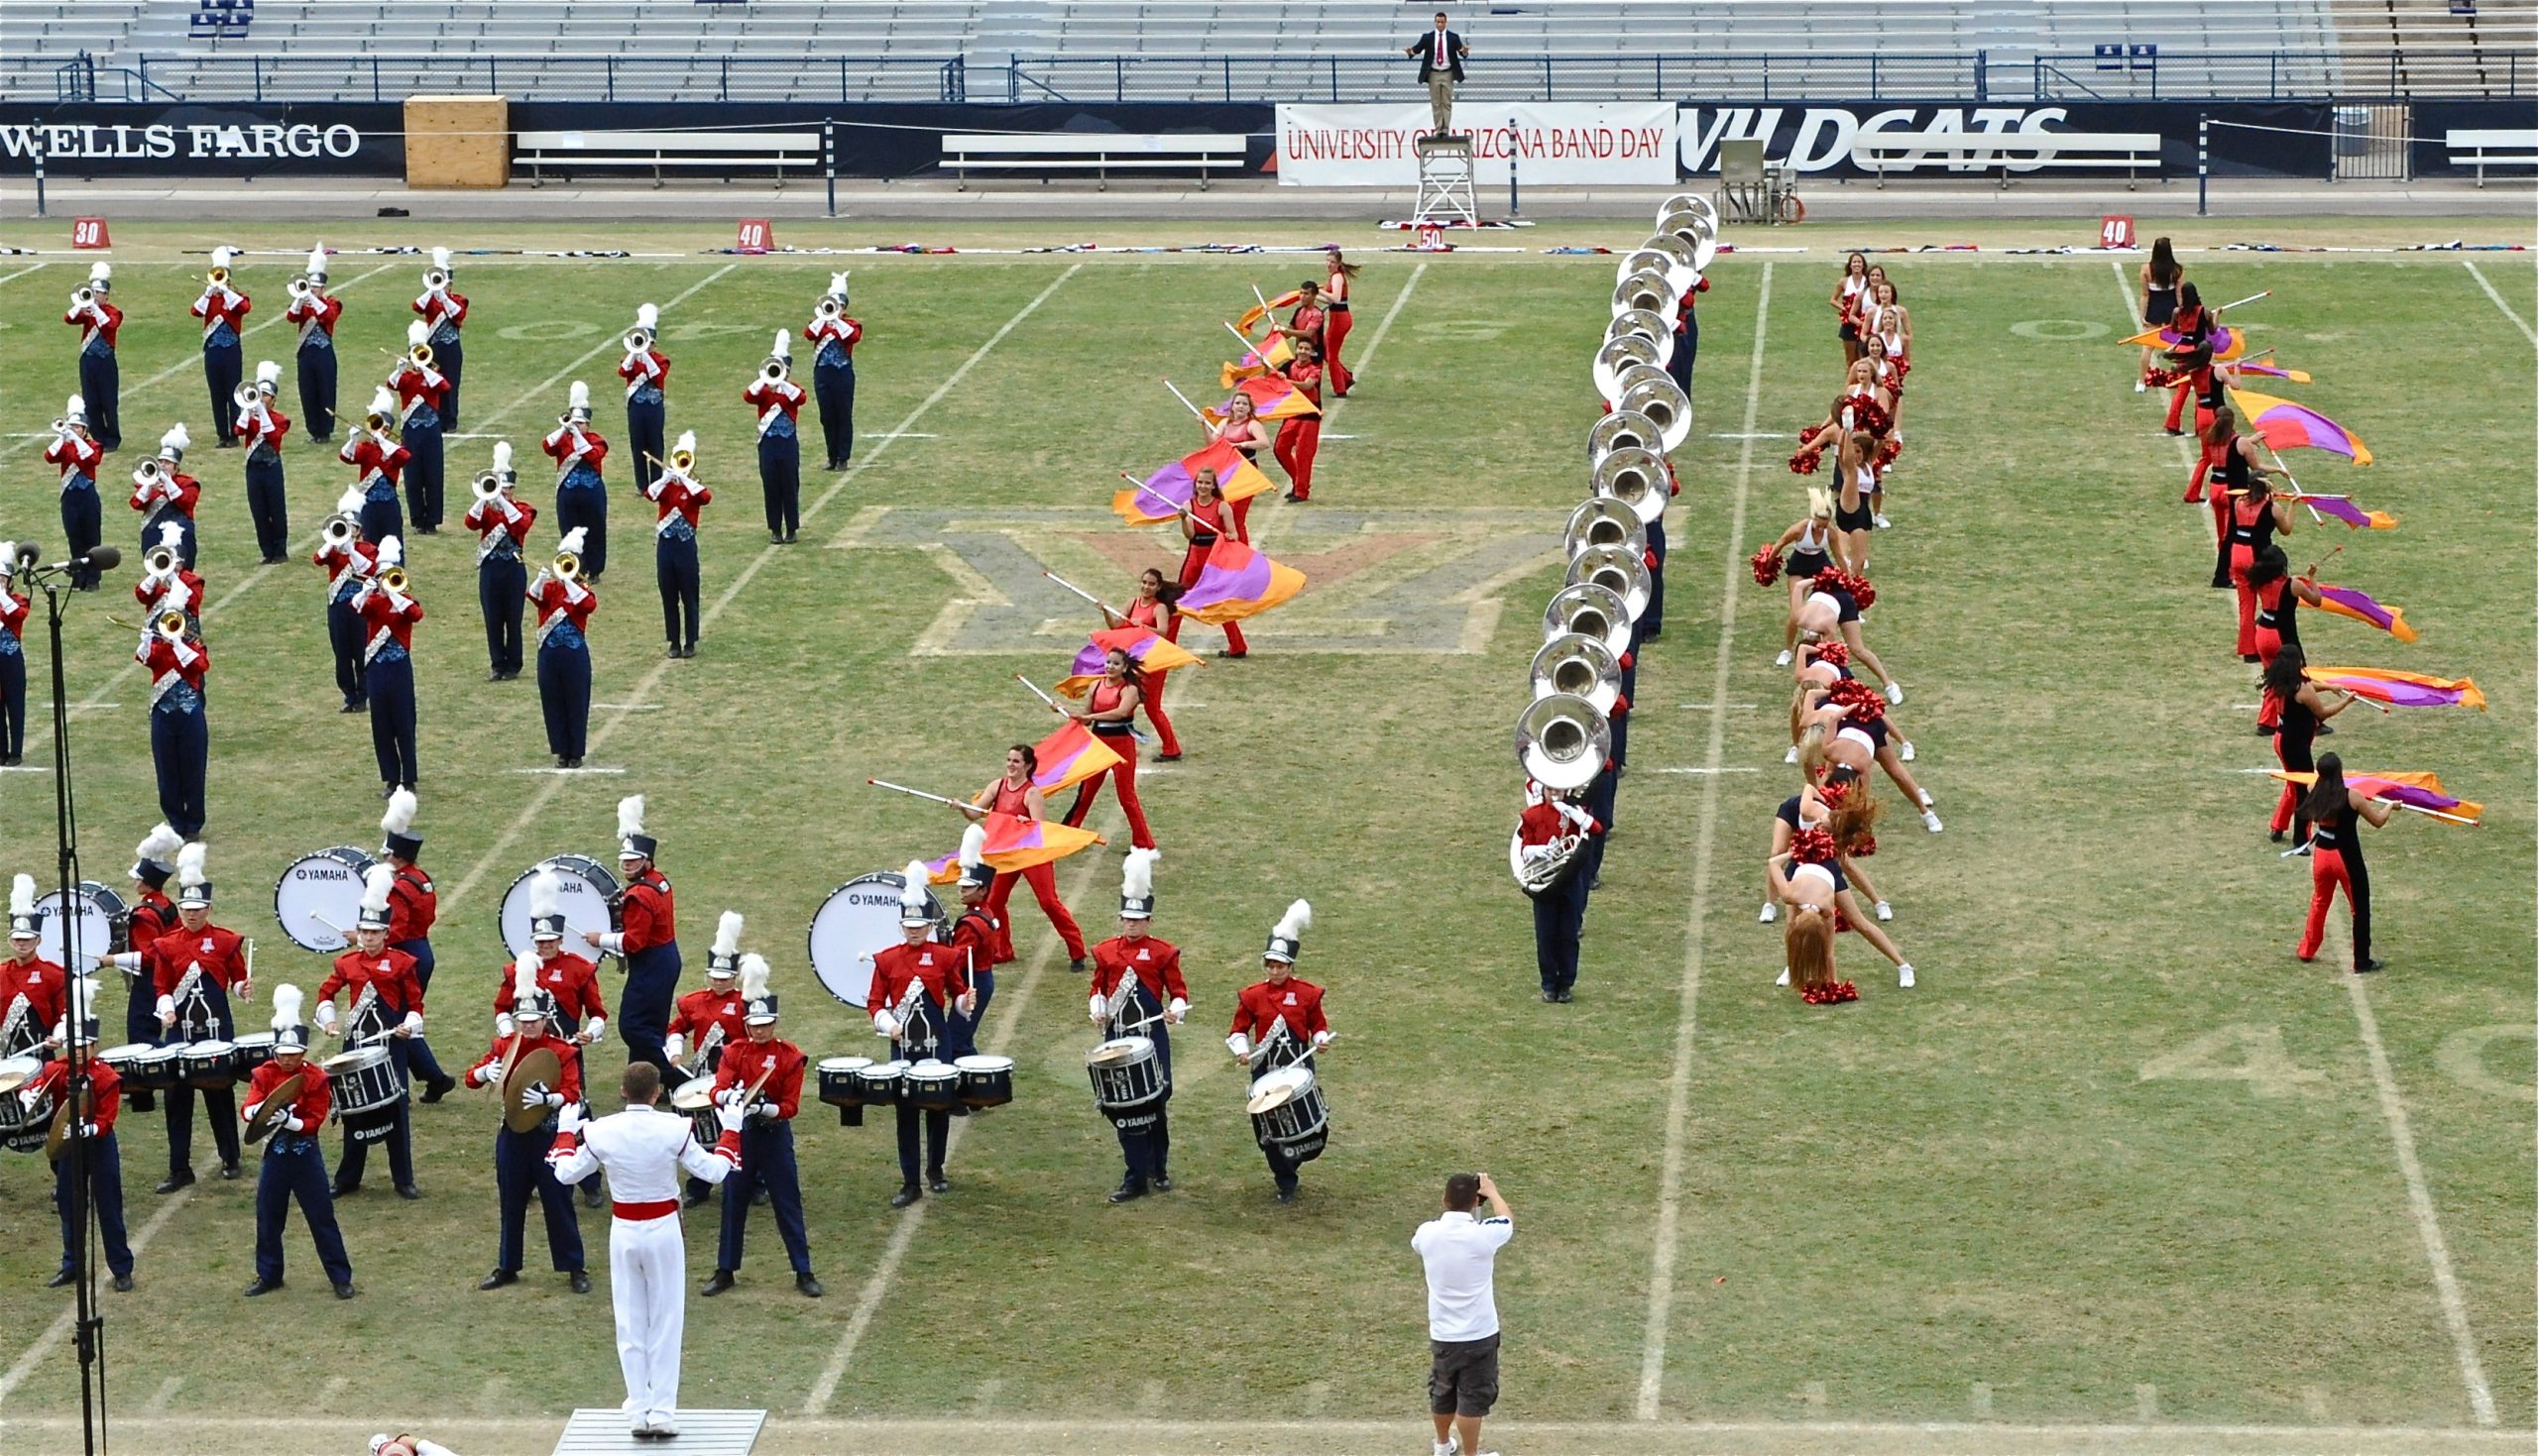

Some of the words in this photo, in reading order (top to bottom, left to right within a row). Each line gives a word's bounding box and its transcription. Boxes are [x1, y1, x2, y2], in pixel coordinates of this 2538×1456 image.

[0, 124, 176, 158] WELLS
[187, 124, 360, 158] FARGO
[1287, 129, 1406, 160] UNIVERSITY
[1552, 128, 1614, 159] BAND
[1621, 128, 1664, 159] DAY
[75, 222, 99, 245] 30
[740, 224, 762, 246] 40
[1421, 229, 1442, 247] 50
[2102, 220, 2126, 244] 40
[308, 869, 349, 881] YAMAHA
[53, 905, 94, 917] YAHA
